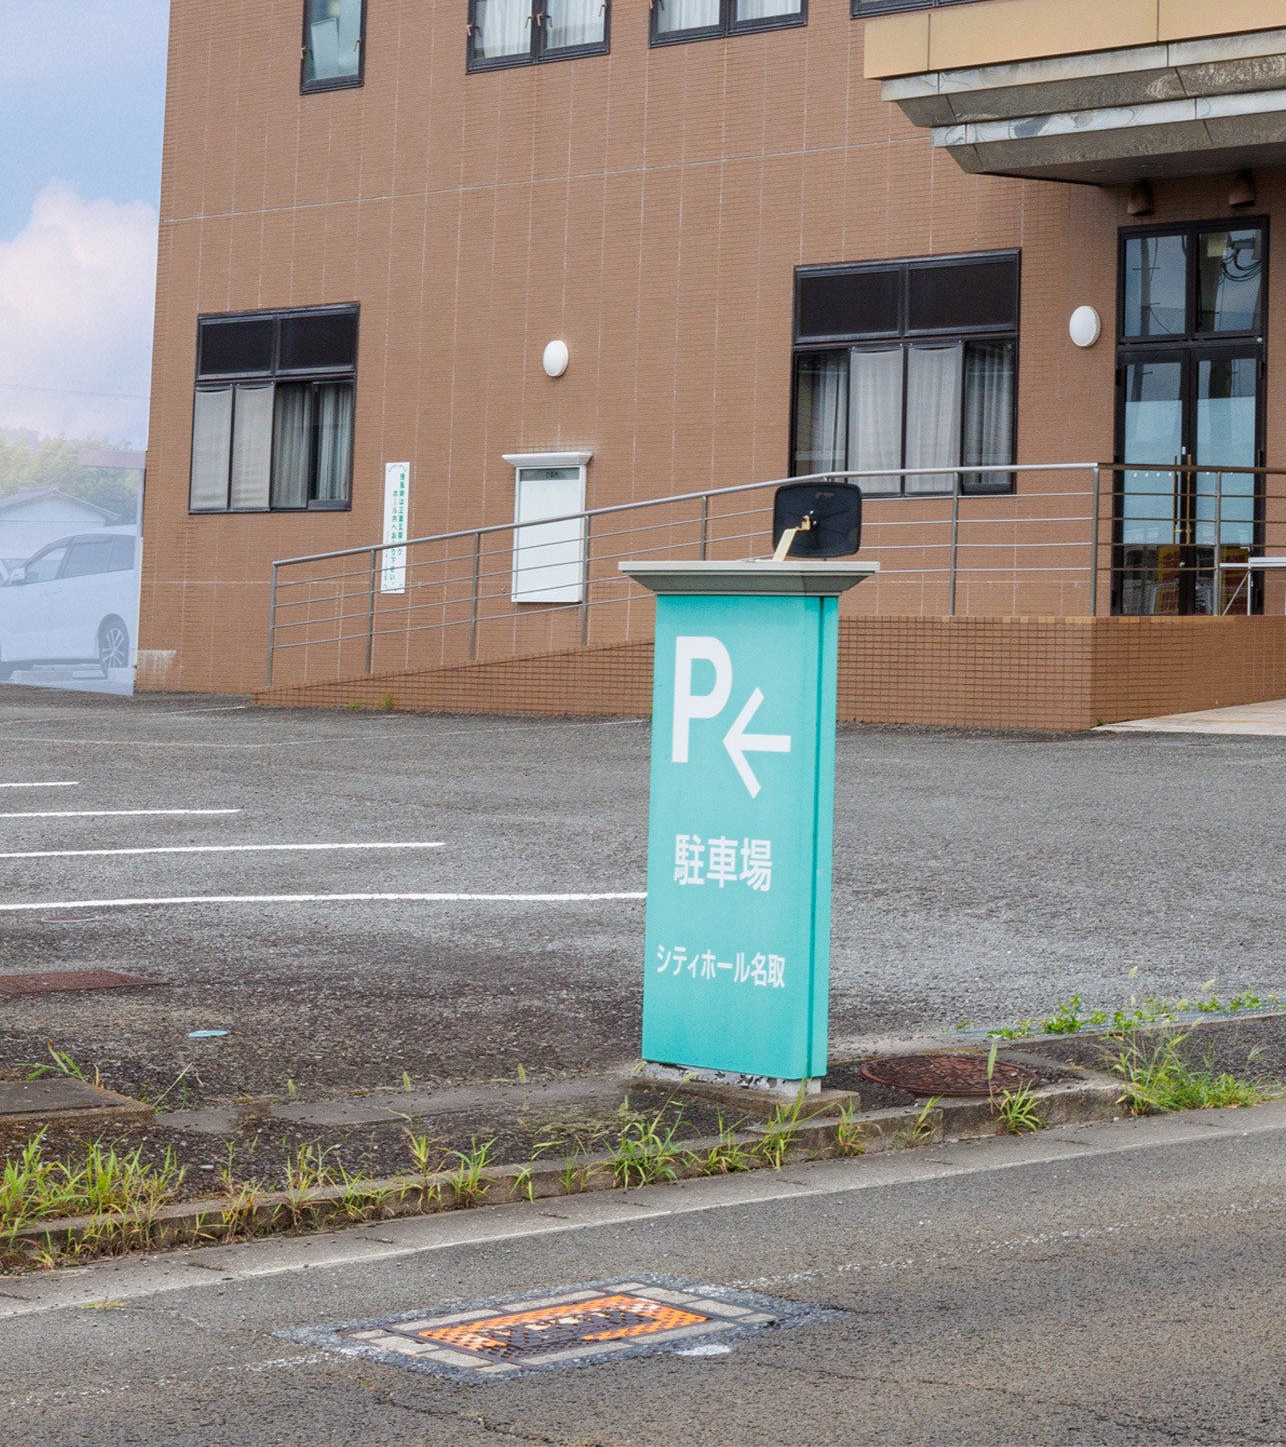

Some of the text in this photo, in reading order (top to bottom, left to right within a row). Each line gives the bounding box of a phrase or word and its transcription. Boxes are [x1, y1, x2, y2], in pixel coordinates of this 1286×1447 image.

[671, 635, 733, 764] P
[672, 834, 773, 893] 駐車場
[656, 944, 786, 990] シティホール名取
